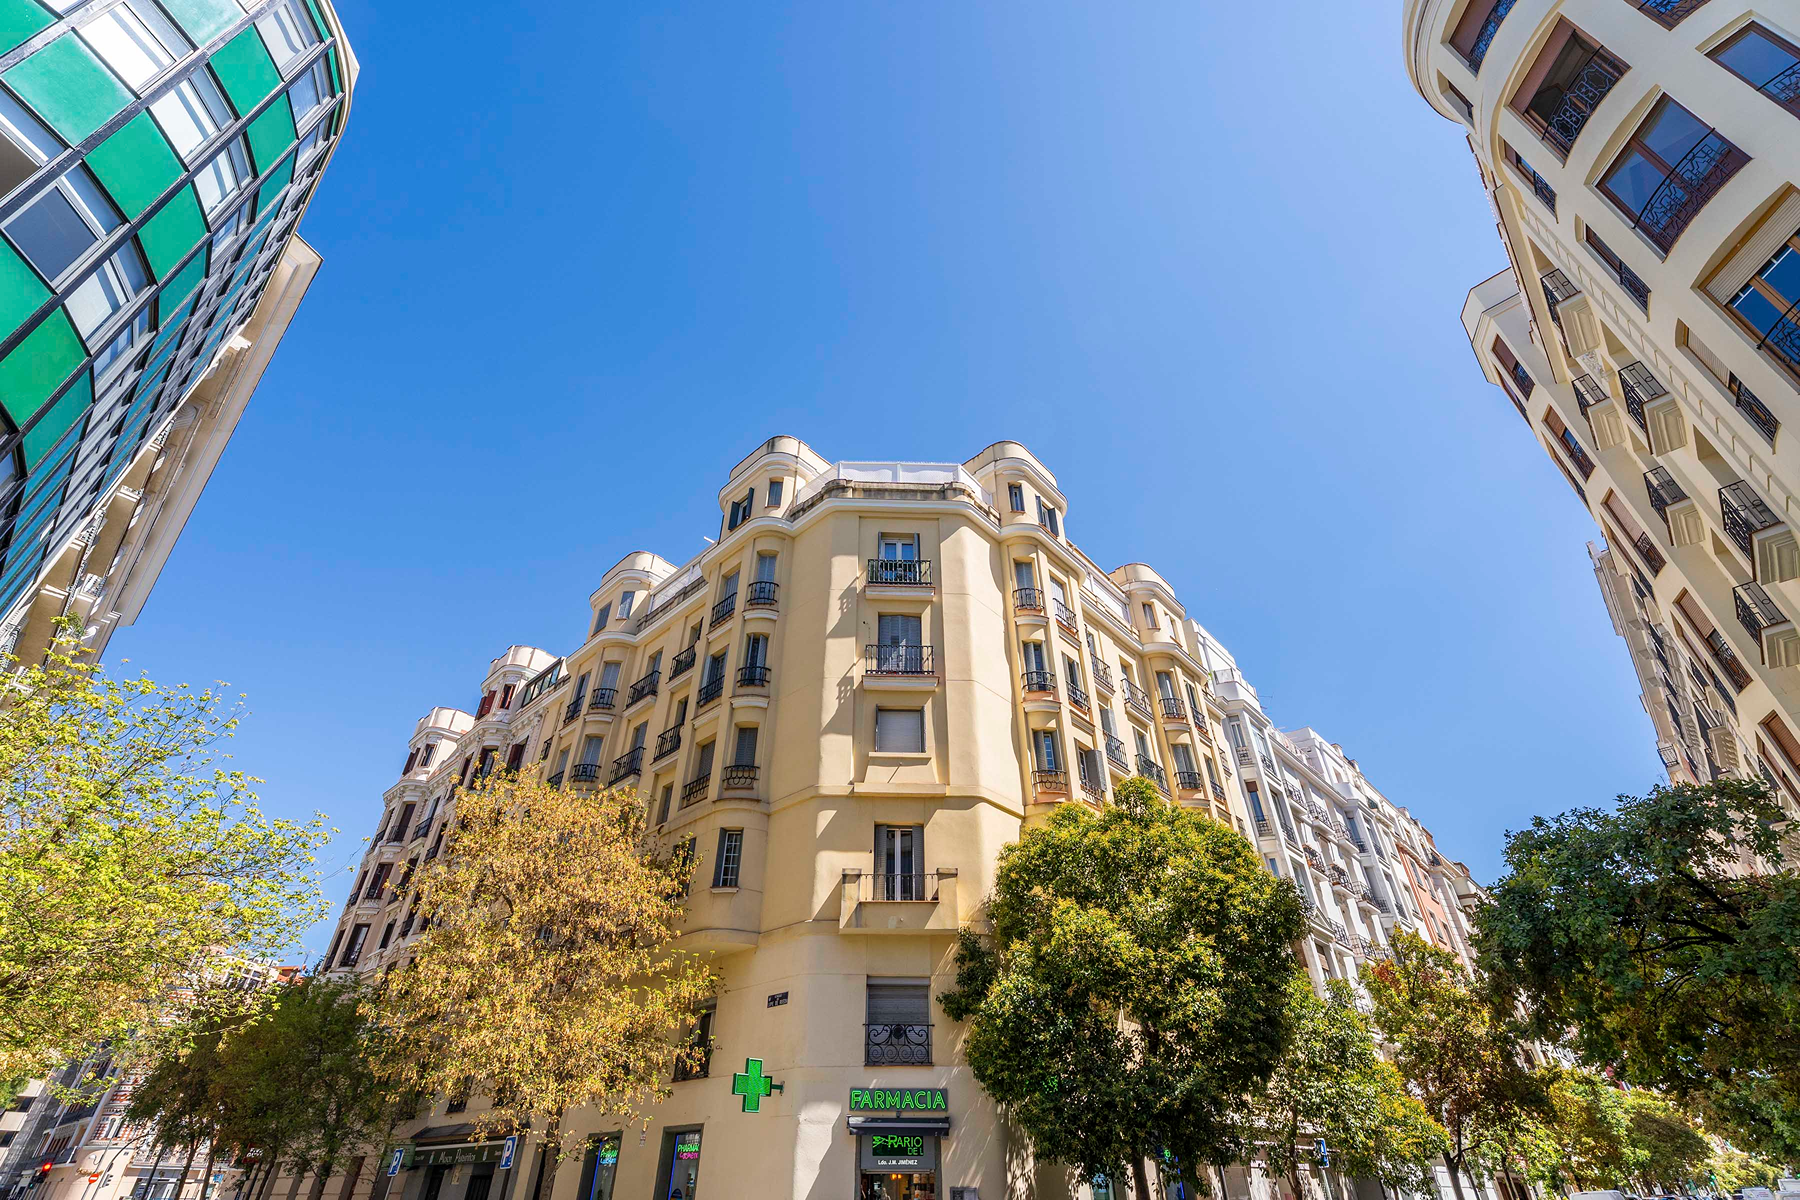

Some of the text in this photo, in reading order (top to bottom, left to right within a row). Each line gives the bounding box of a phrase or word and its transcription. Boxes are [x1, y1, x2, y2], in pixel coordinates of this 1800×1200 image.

[850, 1090, 946, 1109] FARMACIA
[502, 1140, 513, 1165] P
[907, 1147, 918, 1155] DE
[390, 1151, 401, 1173] P
